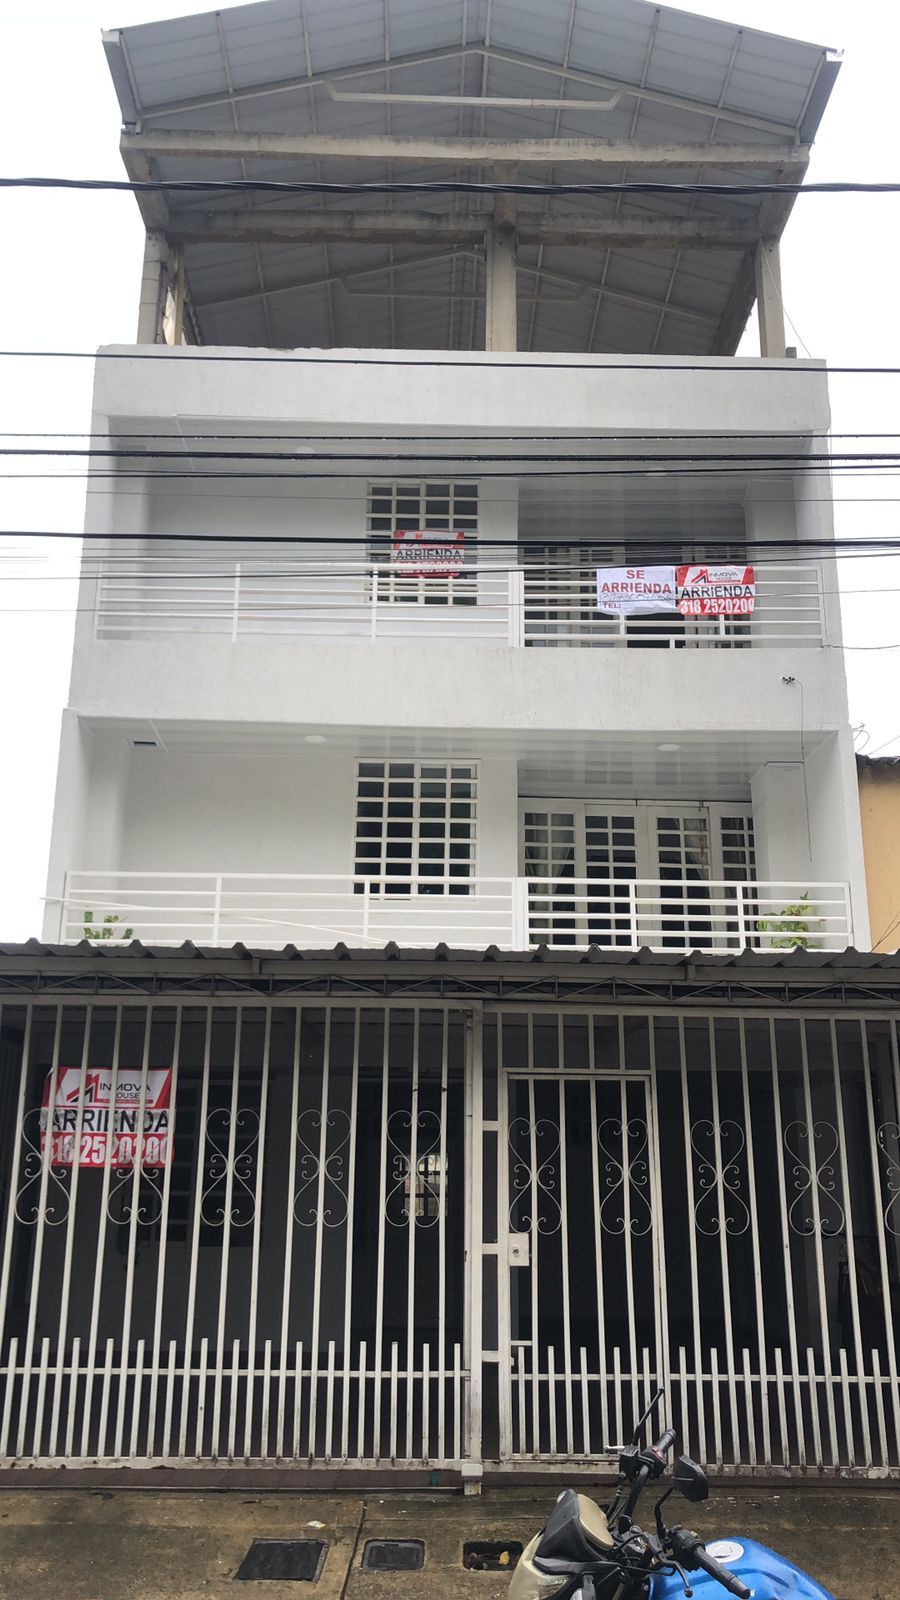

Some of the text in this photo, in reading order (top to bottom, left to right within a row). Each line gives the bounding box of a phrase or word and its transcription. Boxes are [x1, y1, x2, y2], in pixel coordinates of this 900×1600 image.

[626, 570, 645, 580] SE
[601, 582, 672, 594] ARRIENDA
[681, 585, 754, 599] ARRIENDA
[681, 598, 755, 614] 318 2520200
[112, 1091, 140, 1099] OUSE
